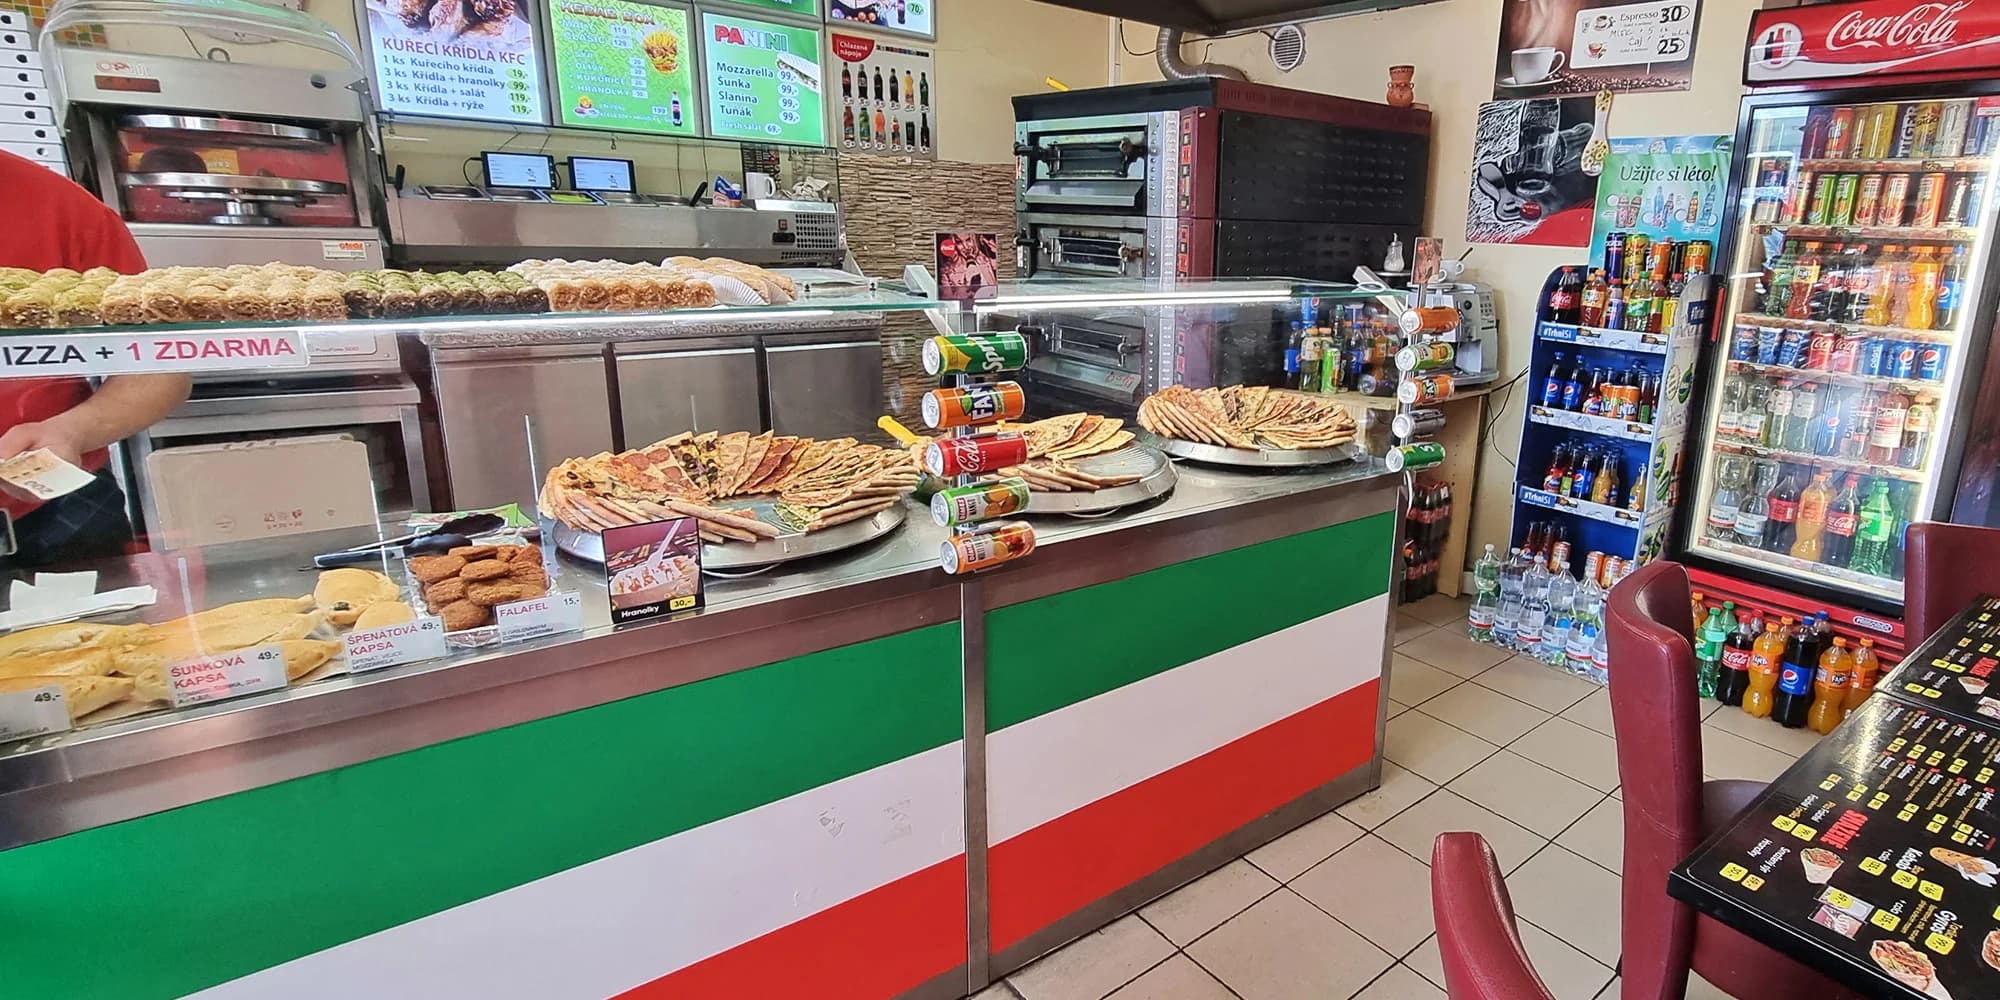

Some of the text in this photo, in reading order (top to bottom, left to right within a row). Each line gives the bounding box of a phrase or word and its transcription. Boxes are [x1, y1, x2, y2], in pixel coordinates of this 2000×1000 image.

[1620, 11, 1659, 22] Espresso
[1826, 0, 1973, 50] Coca-Cola
[714, 25, 788, 52] PANINI
[382, 37, 526, 65] KUŘECÍ KŘÍDLA KFC
[392, 55, 406, 66] ks
[462, 62, 494, 74] křídla
[716, 62, 774, 78] Mozzarella
[384, 68, 392, 76] 3
[394, 68, 407, 78] ks
[412, 70, 446, 82] Křídla
[458, 76, 506, 90] hranolky
[718, 76, 751, 89] Šunka
[386, 80, 393, 90] 3
[396, 81, 409, 92] ks
[414, 82, 448, 96] Křídla
[460, 87, 486, 98] salát
[719, 90, 758, 104] Slanina
[388, 94, 395, 102] 3
[398, 94, 411, 104] ks
[416, 96, 449, 108] Křídla
[461, 98, 485, 110] rýže
[720, 104, 752, 117] Tuňák
[1620, 164, 1717, 184] Užijte si léto!
[2, 337, 296, 366] IZZA + 1 ZDARMA
[499, 602, 549, 618] FALAFEL
[620, 604, 660, 618] Hranolky
[349, 642, 394, 657] KAPSA
[173, 672, 226, 690] KAPSA
[1820, 808, 1868, 850] SMAŽENÉ
[1895, 847, 1924, 870] Kebab
[1930, 910, 1958, 934] Gyros
